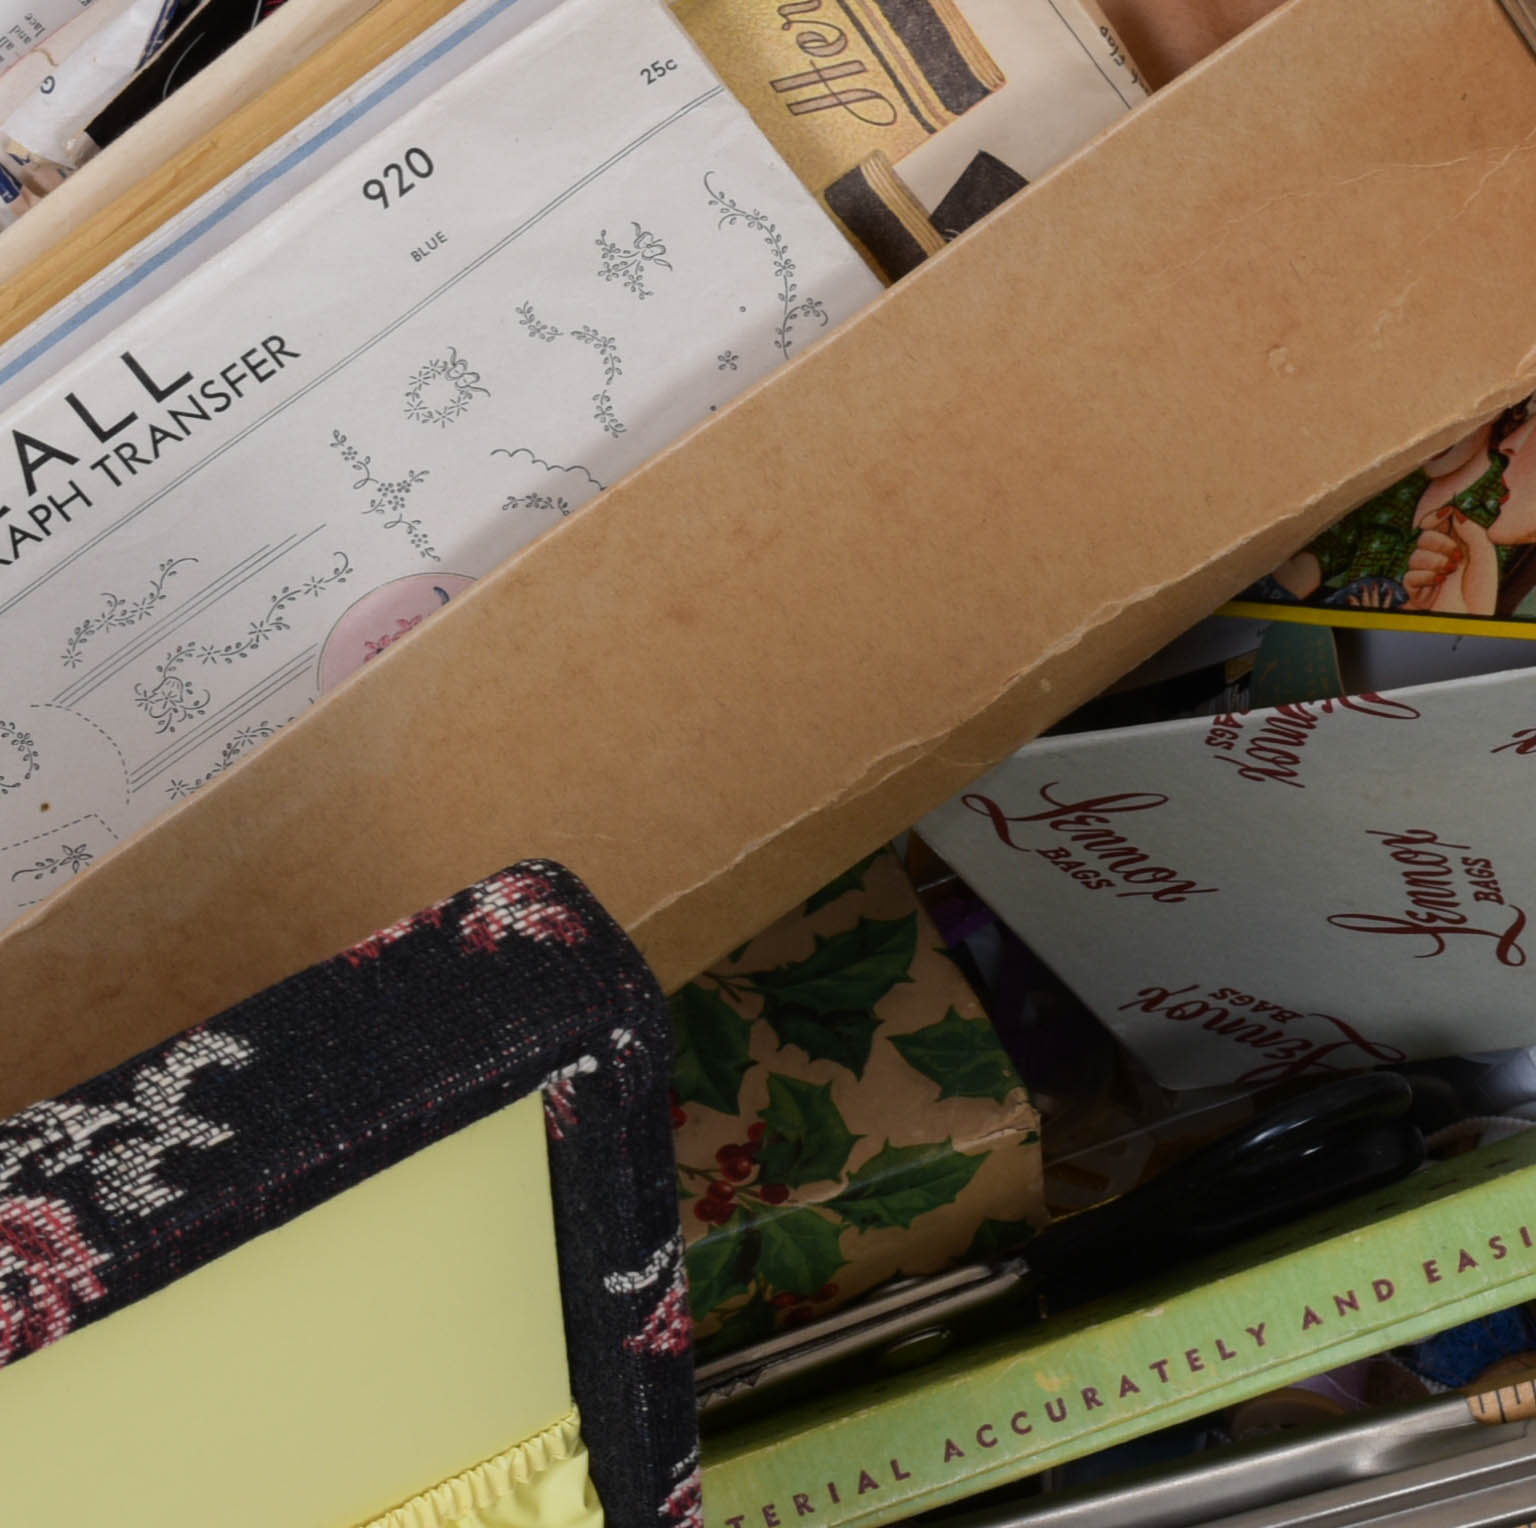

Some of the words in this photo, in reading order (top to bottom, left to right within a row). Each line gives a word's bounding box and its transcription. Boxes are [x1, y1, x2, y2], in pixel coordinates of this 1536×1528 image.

[9, 24, 32, 45] and
[23, 12, 46, 37] lace
[638, 57, 679, 86] 25c
[362, 145, 436, 210] 920
[409, 228, 449, 264] BLUE
[90, 334, 302, 488] TRANSFER
[960, 781, 1220, 905] Lennox
[1034, 846, 1117, 892] BAGS
[1461, 855, 1505, 905] BAGS
[1325, 828, 1527, 967] Lennox
[1209, 985, 1305, 1020] BAGS
[942, 1321, 1270, 1465] ACCURATELY
[1300, 1277, 1397, 1334] AND
